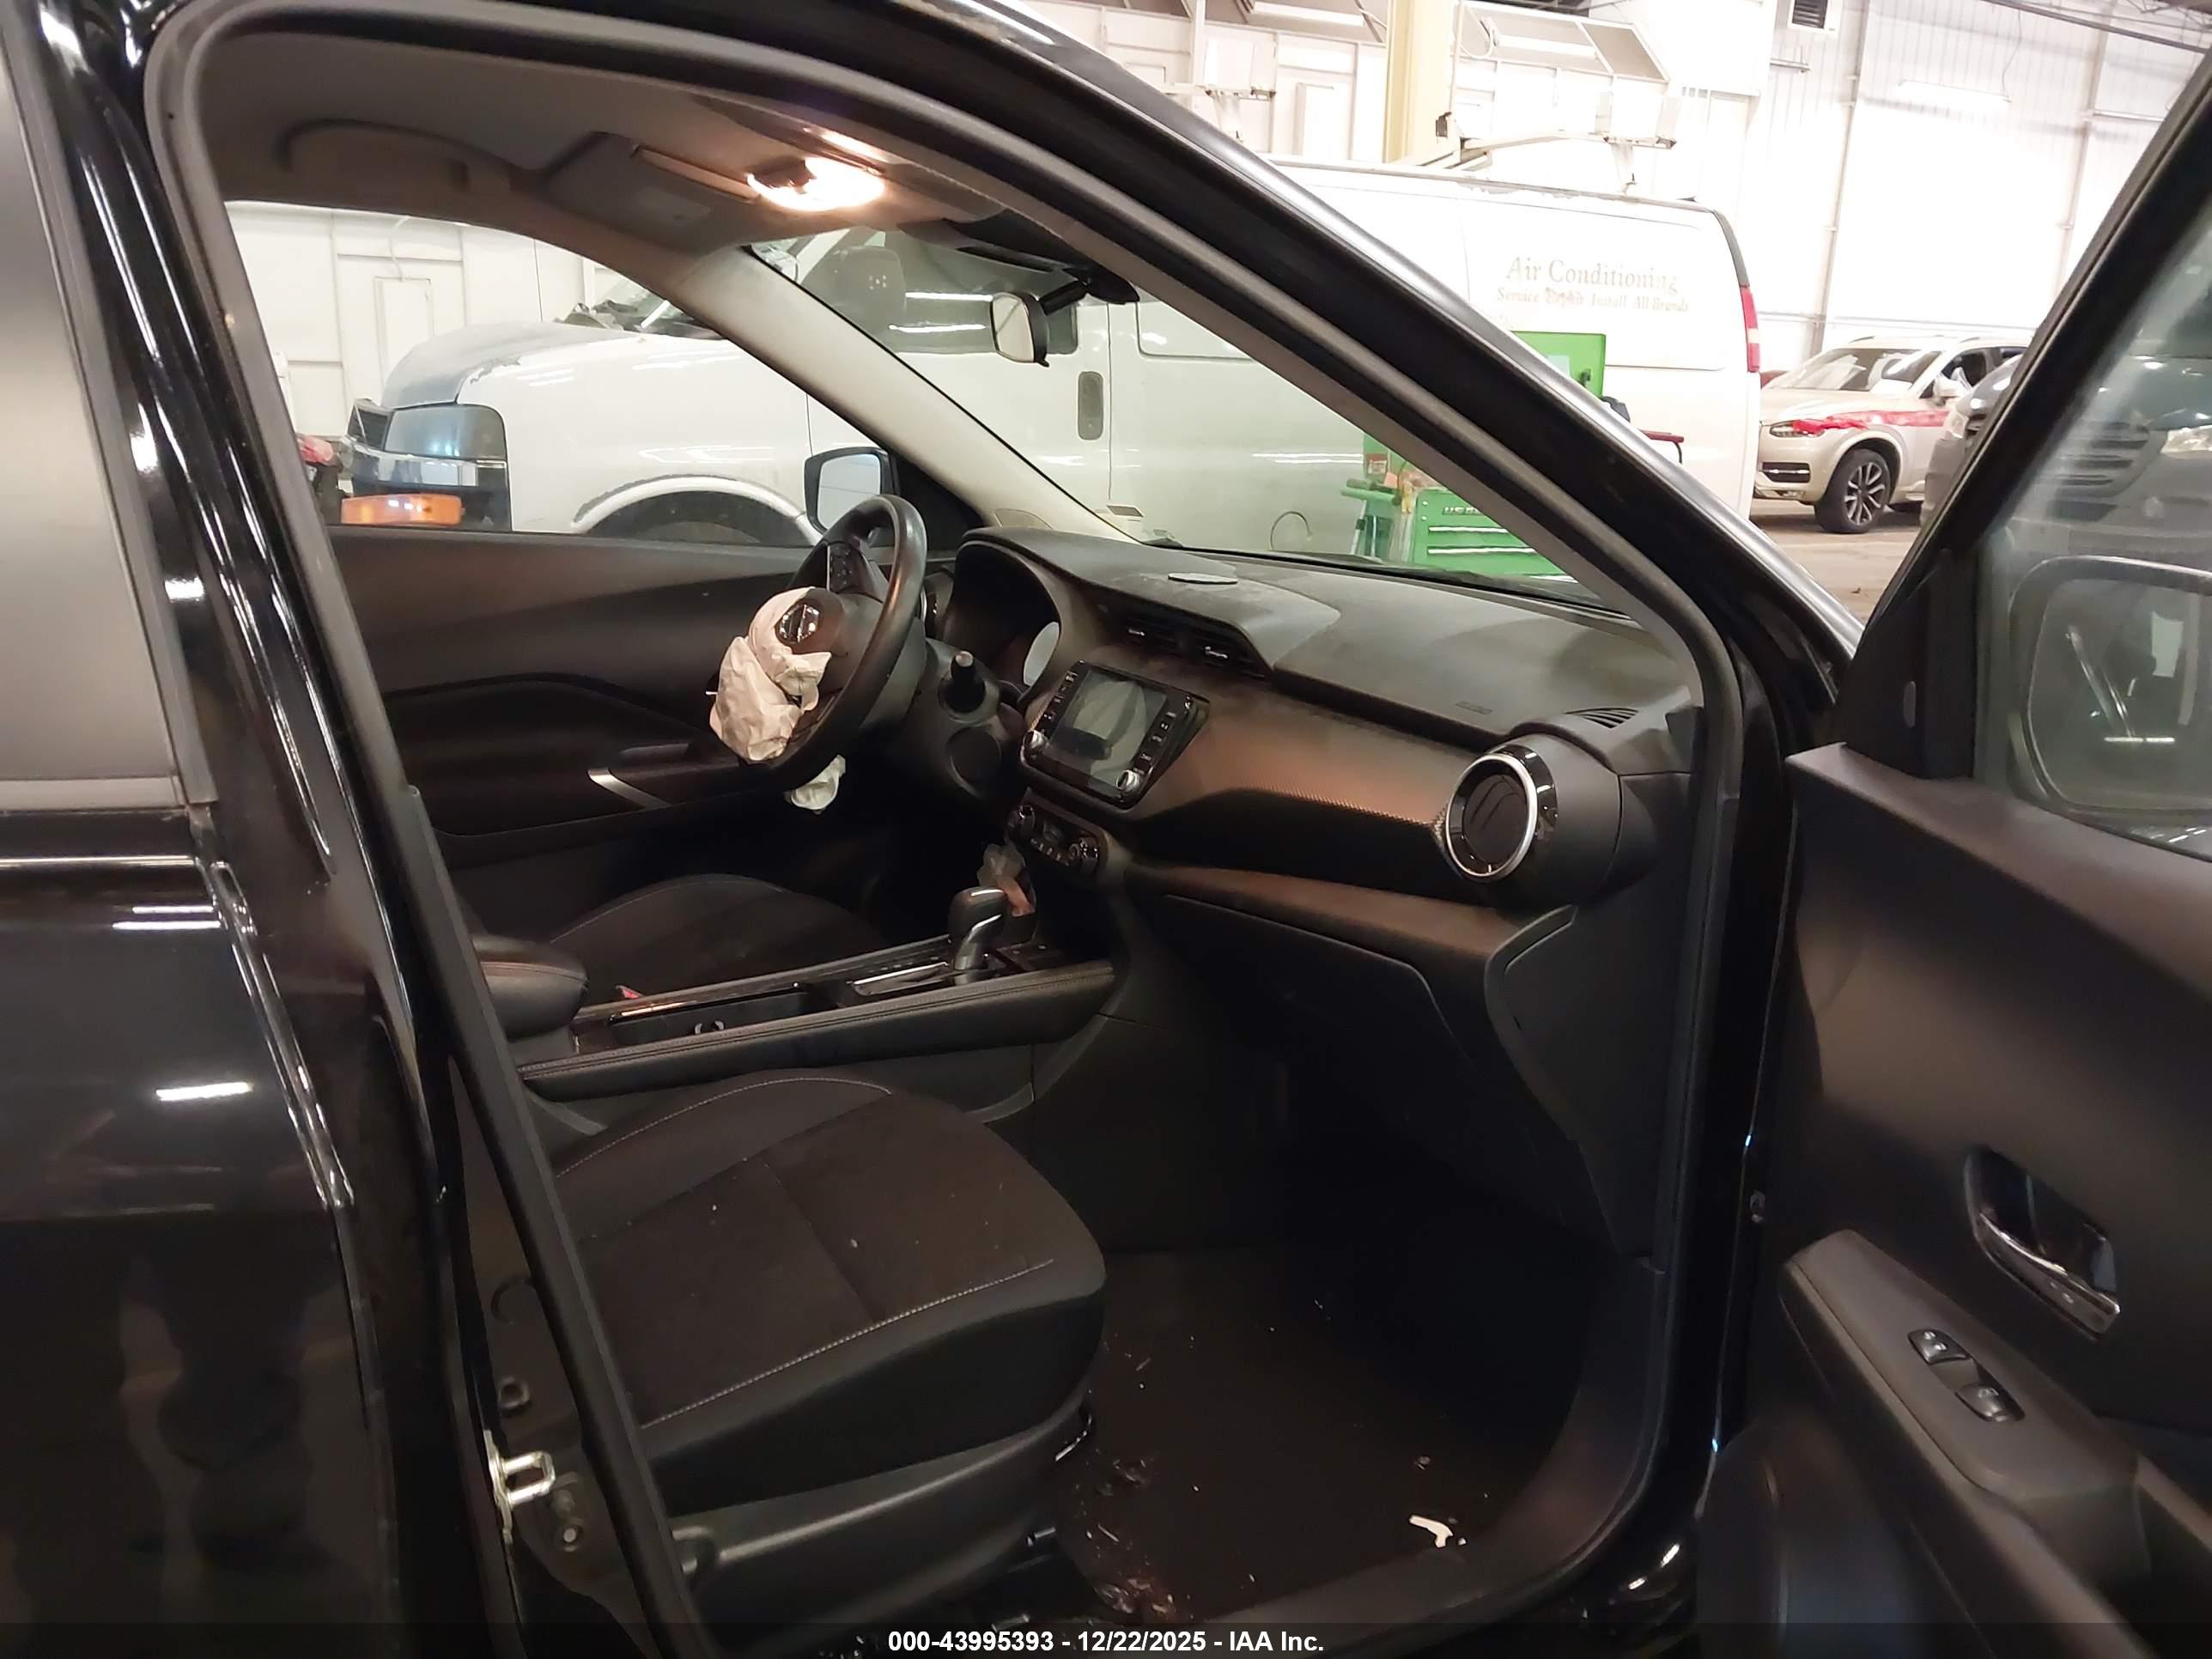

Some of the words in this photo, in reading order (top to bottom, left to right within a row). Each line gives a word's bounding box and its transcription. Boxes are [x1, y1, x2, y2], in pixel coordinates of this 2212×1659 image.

[1505, 257, 1541, 281] Air
[1548, 258, 1678, 295] Conditioning
[1591, 293, 1627, 308] Install
